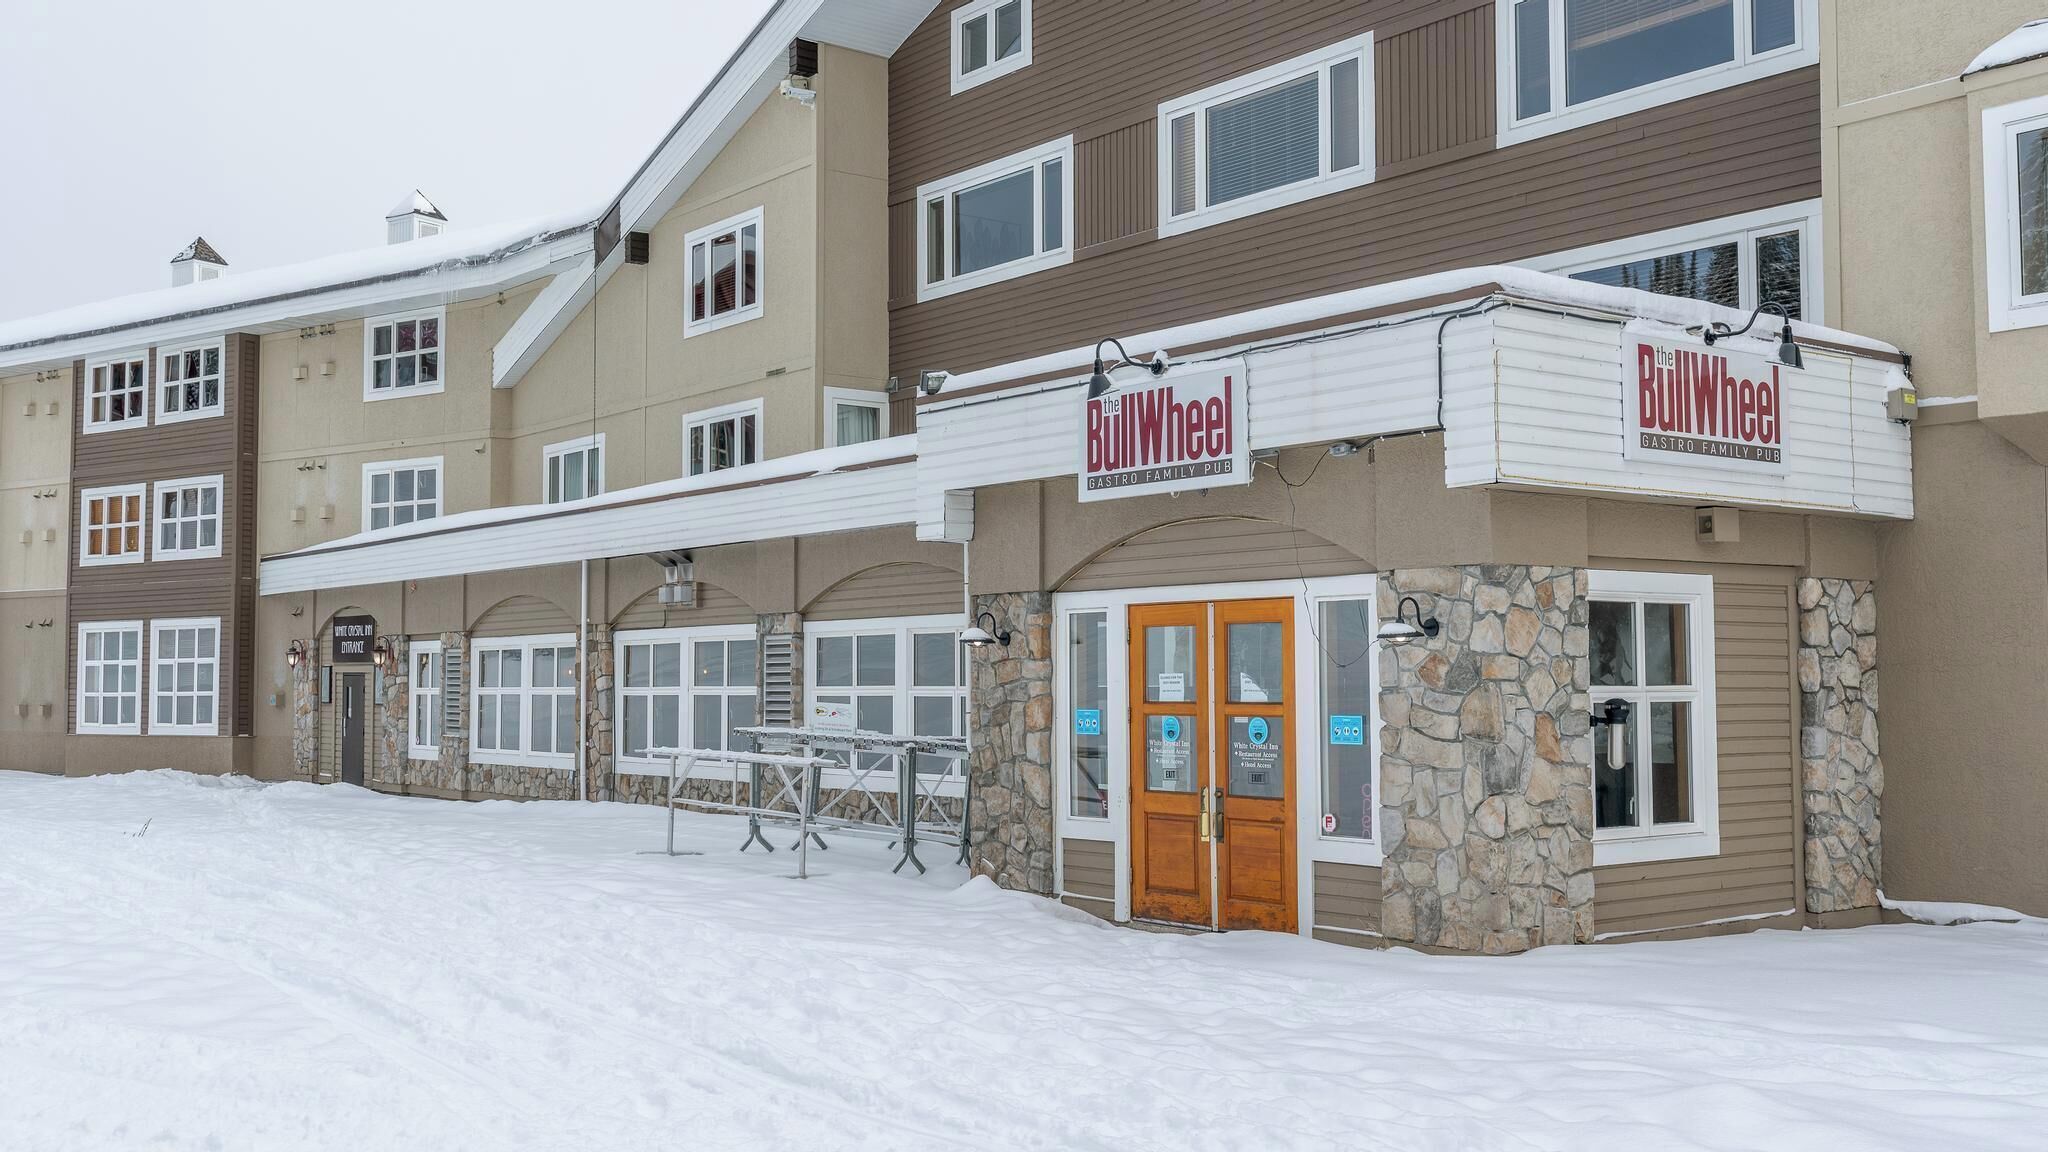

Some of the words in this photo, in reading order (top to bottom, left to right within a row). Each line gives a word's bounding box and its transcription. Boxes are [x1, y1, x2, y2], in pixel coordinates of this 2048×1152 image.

[1656, 346, 1673, 366] the
[1637, 343, 1781, 445] BullWheel
[1104, 396, 1119, 414] the
[1087, 375, 1233, 474] BullWheel
[1642, 435, 1694, 452] GASTRO
[1702, 442, 1749, 458] FAMILY
[1757, 449, 1780, 462] PUB
[1089, 473, 1138, 489] GASTRO
[1146, 464, 1196, 482] FAMILY
[1204, 461, 1232, 475] PUB
[335, 626, 347, 636] WHITE
[348, 625, 364, 636] CRYSTAL
[342, 641, 364, 653] ENTRANCE
[1249, 742, 1268, 750] Crystal
[1165, 770, 1176, 779] EXIT
